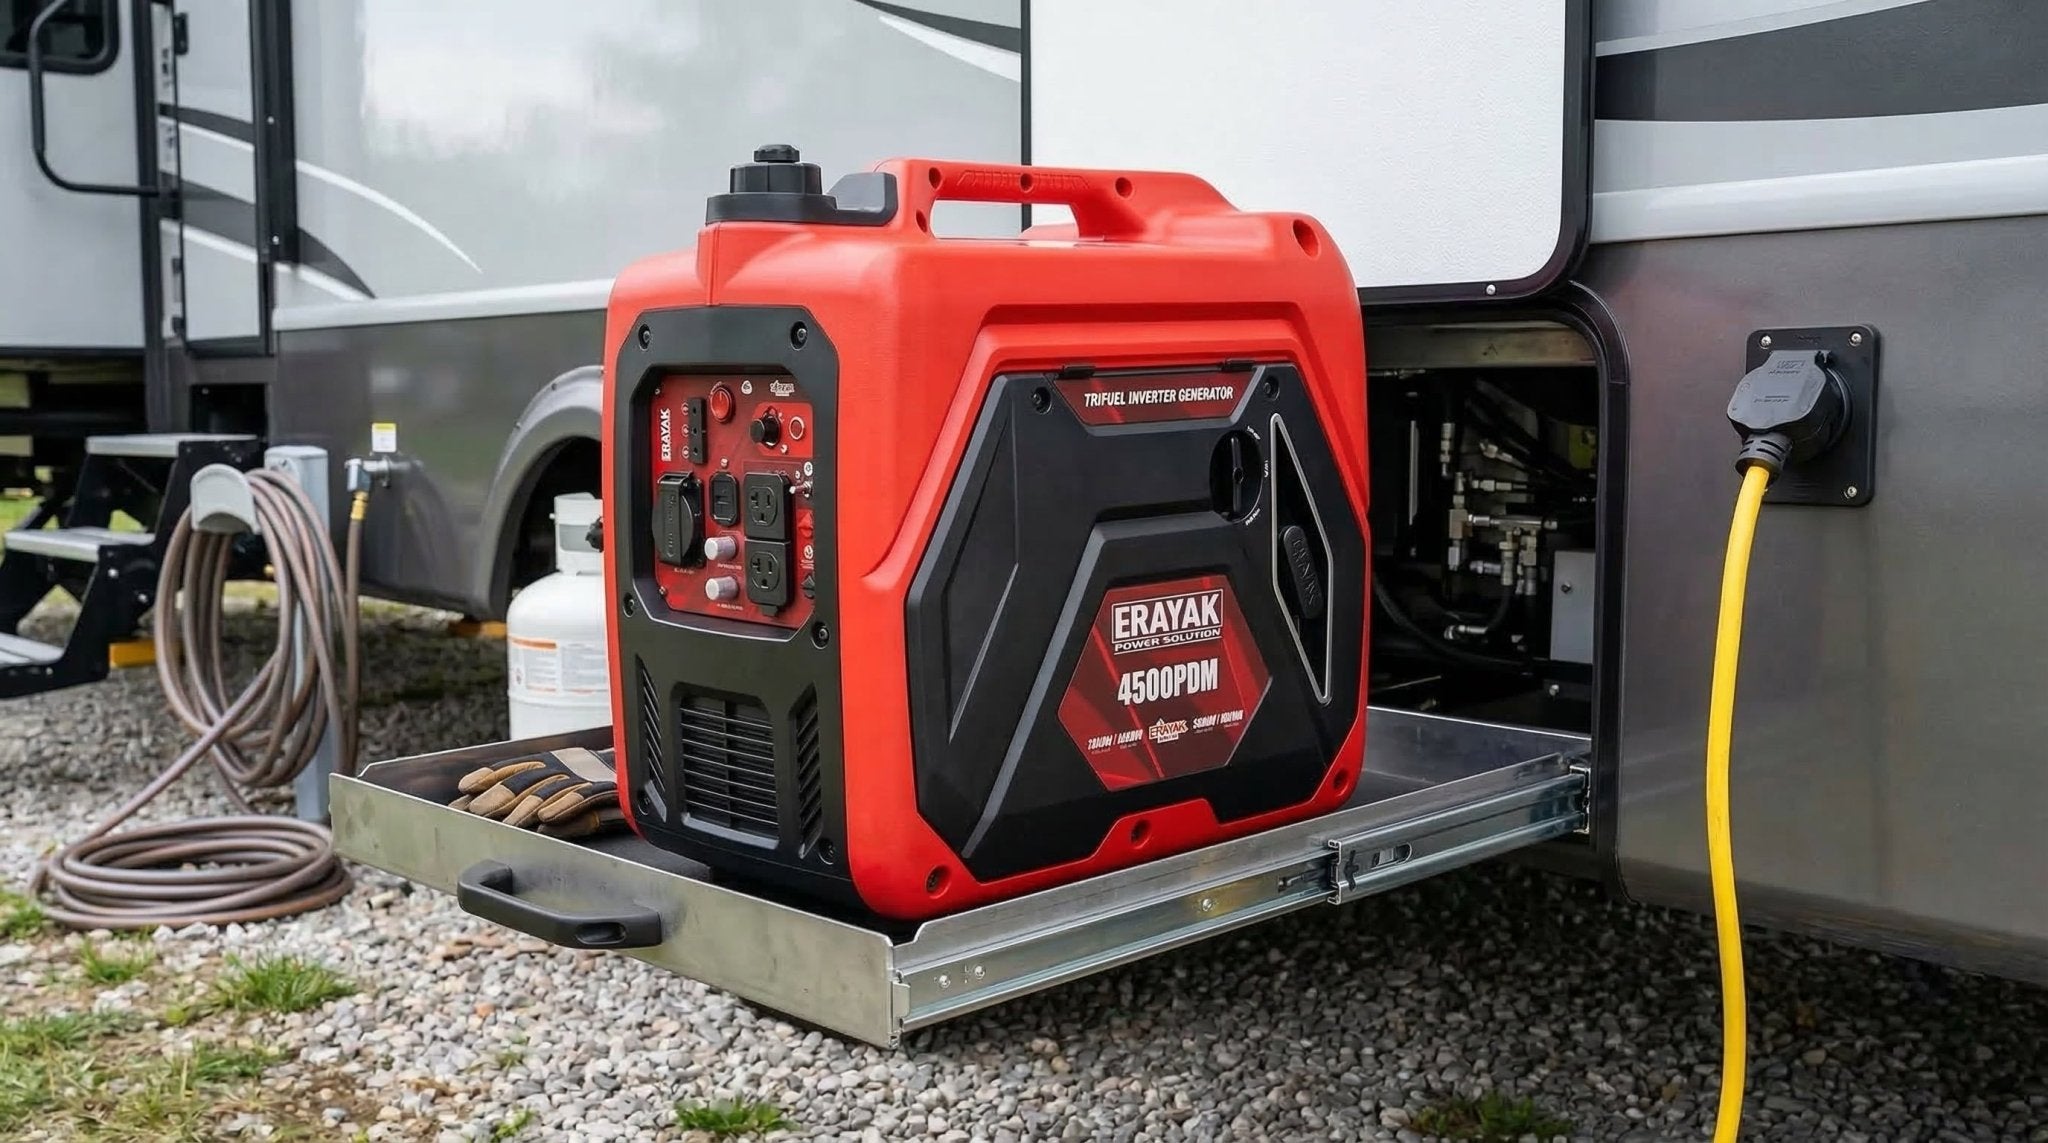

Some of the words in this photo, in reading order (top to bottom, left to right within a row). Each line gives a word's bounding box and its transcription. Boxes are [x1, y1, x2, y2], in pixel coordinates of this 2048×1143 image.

[1084, 392, 1126, 407] TRIFUEL
[1128, 389, 1176, 405] INVERTER
[1178, 386, 1234, 402] GENERATOR
[661, 407, 672, 462] ERAYAK
[1114, 593, 1221, 640] ERAYAK
[1114, 637, 1160, 652] POWER
[1163, 628, 1221, 644] SOLUTION
[1117, 658, 1219, 706] 4500PDM
[1150, 721, 1188, 739] ERAYAK
